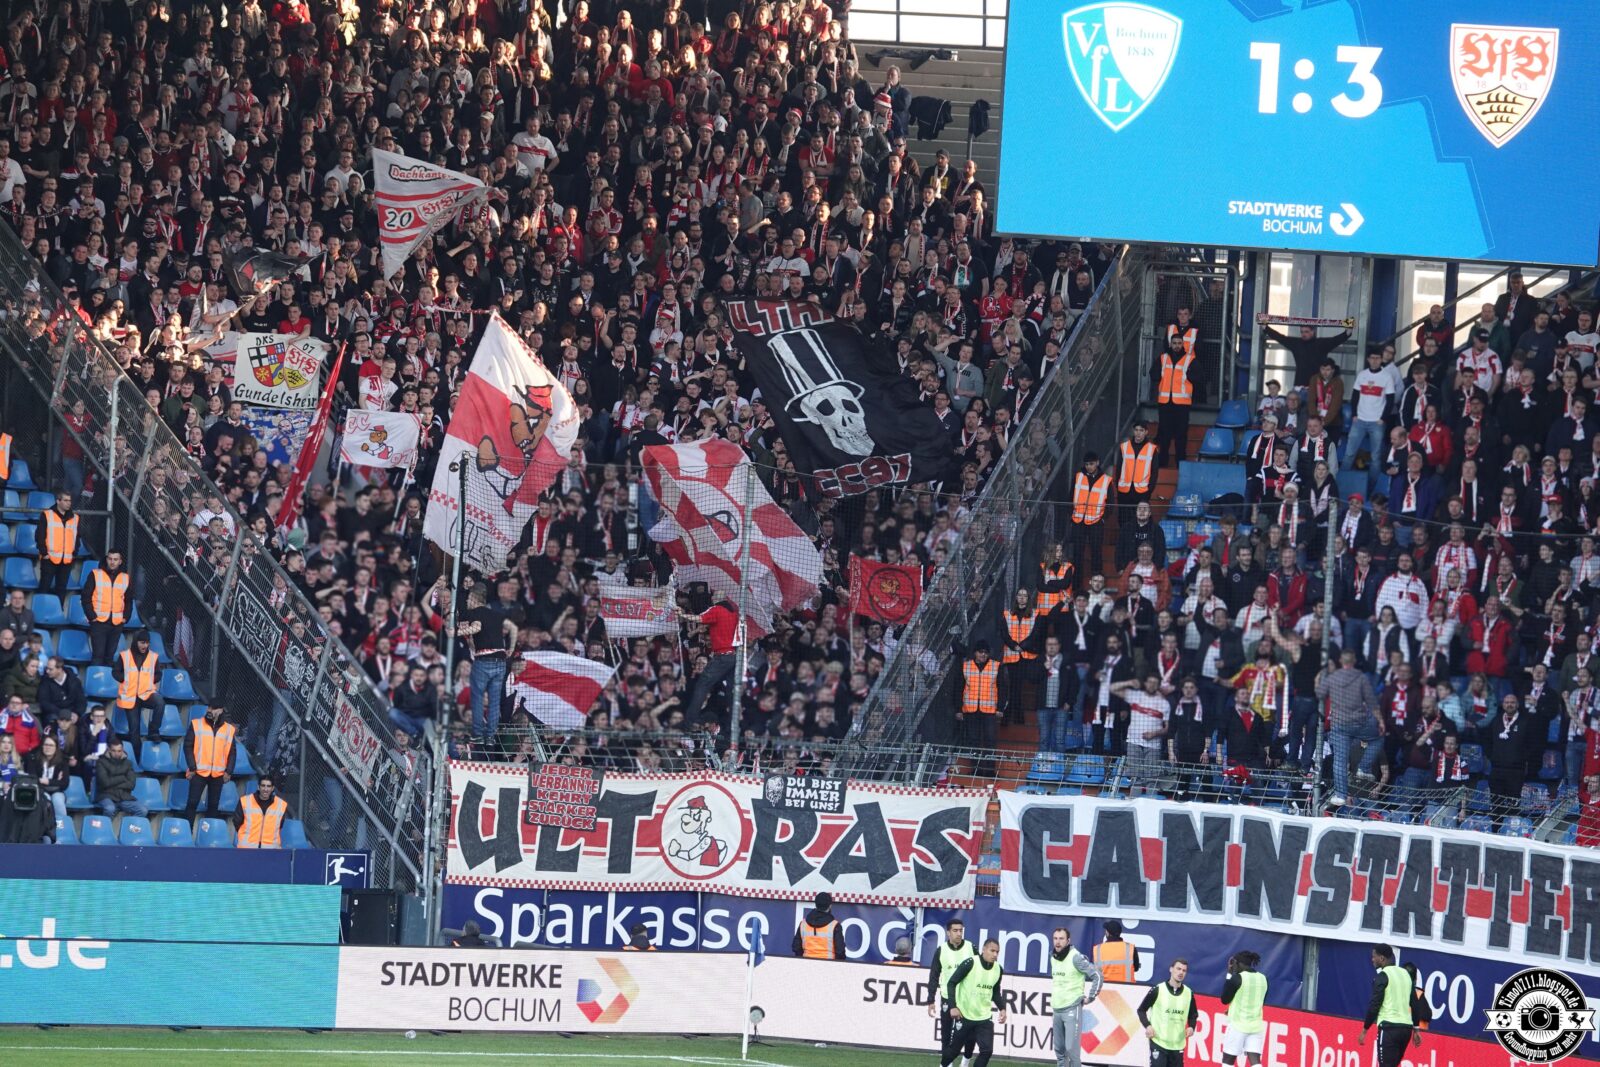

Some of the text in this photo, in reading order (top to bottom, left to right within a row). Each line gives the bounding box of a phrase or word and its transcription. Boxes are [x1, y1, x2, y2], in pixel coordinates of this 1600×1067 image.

[1116, 27, 1167, 39] Bochum
[1127, 46, 1155, 56] 1848
[1460, 32, 1550, 80] VfB
[1228, 200, 1323, 218] STADTWERKE
[386, 211, 412, 228] 20
[1263, 219, 1323, 234] BOCHUM
[255, 335, 274, 346] DKS
[302, 343, 315, 354] 07
[541, 764, 593, 778] JEDER
[531, 773, 600, 794] VERBANNTE
[786, 776, 841, 790] DU BIST
[537, 789, 592, 804] KEHRT
[786, 787, 840, 802] IMMER
[785, 798, 840, 811] BEI UNS!
[473, 888, 770, 952] Sparkasse
[381, 961, 562, 988] STADTWERKE
[448, 997, 561, 1023] BOCHUM
